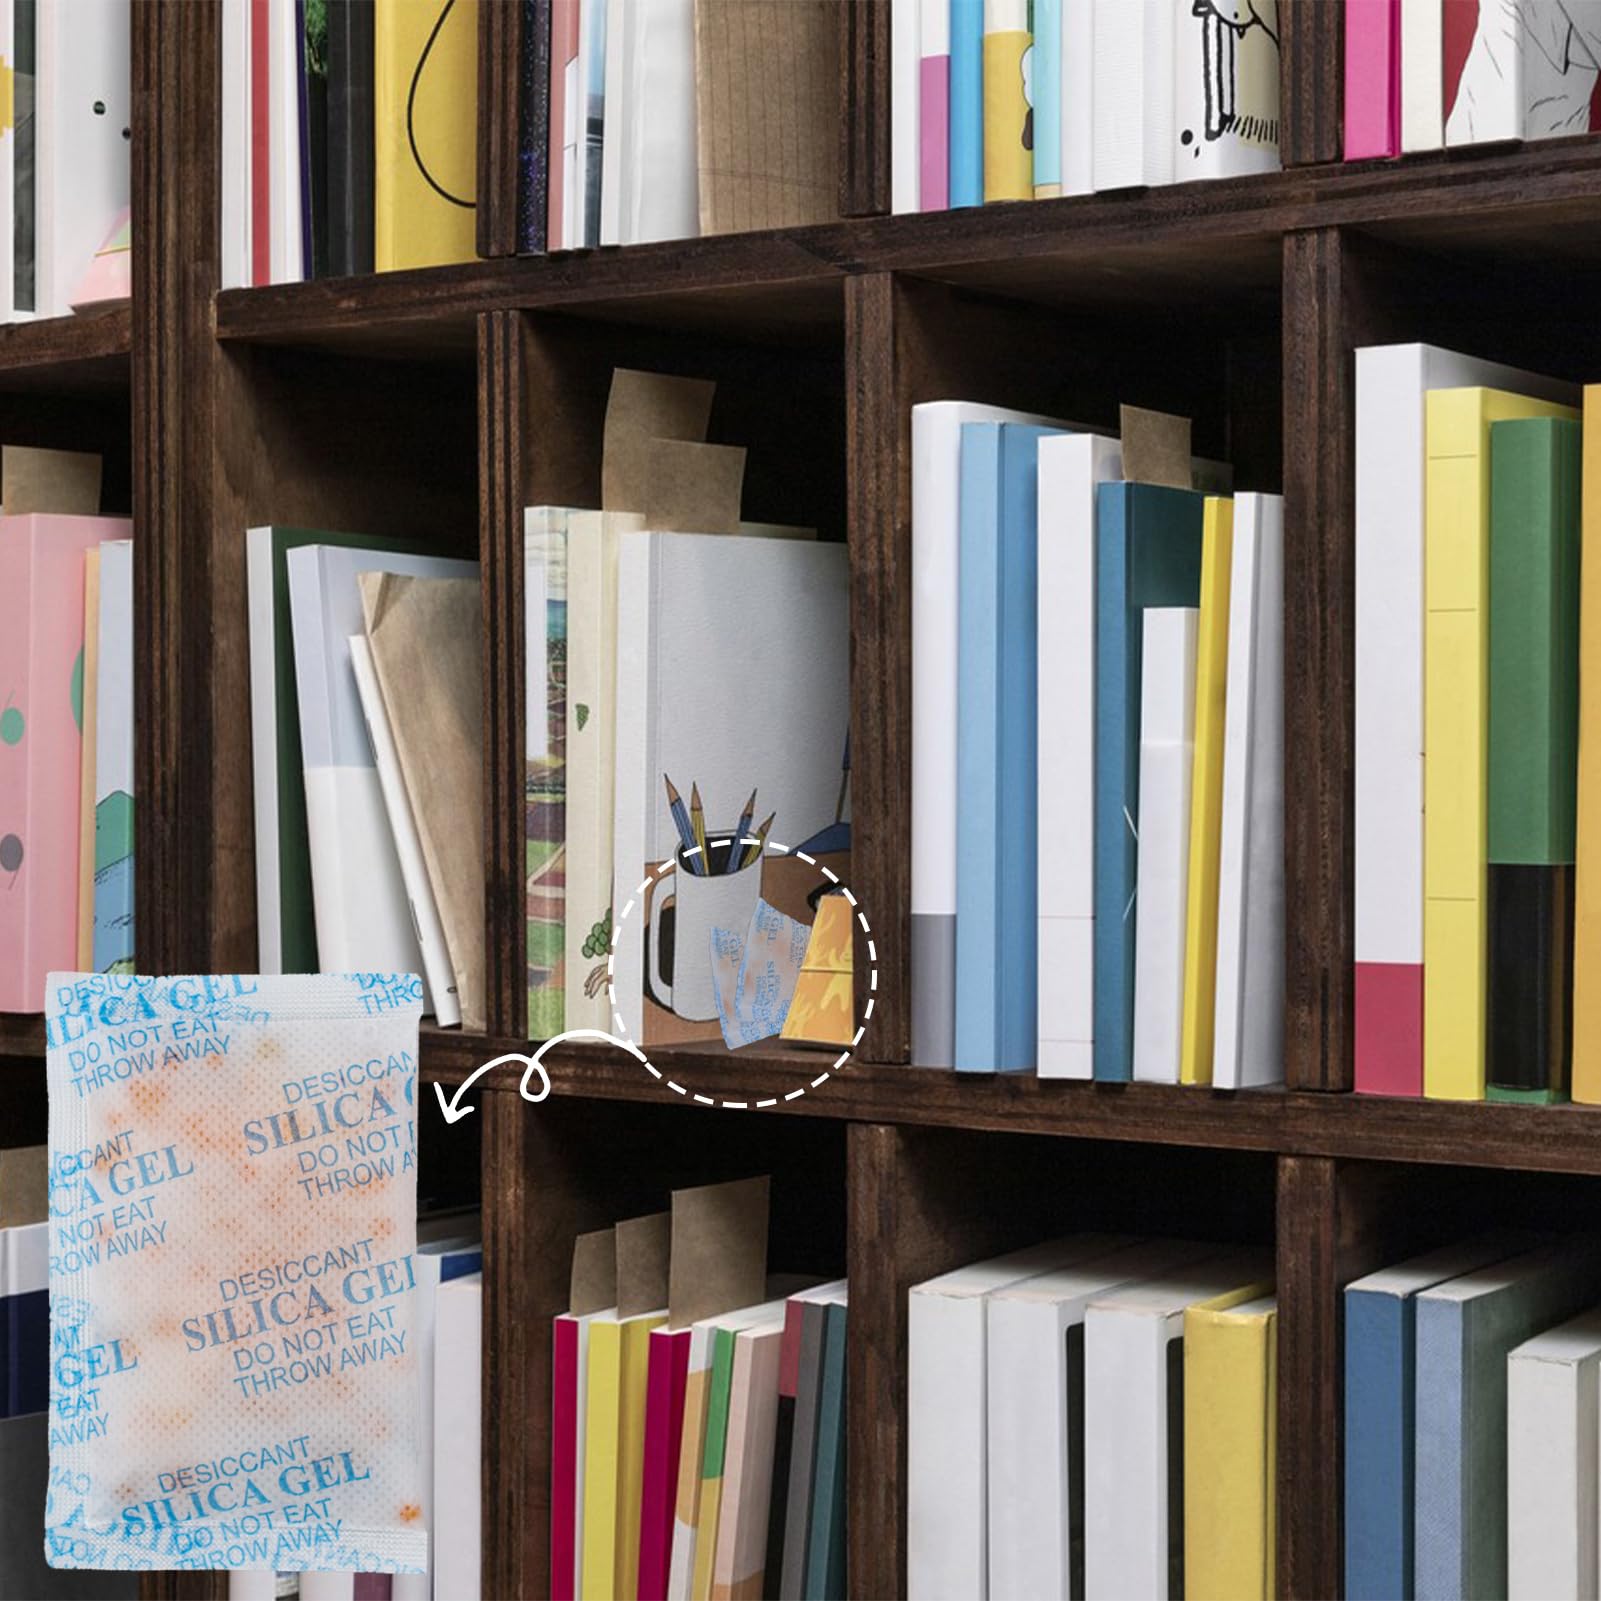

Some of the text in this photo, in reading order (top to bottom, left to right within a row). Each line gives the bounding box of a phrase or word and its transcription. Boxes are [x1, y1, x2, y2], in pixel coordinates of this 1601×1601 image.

[68, 1041, 101, 1074] DO
[107, 1024, 163, 1056] NOT
[172, 1010, 221, 1041] EAT
[71, 1034, 231, 1098] THROW AWAY
[243, 1086, 398, 1157] SILICA
[297, 1144, 339, 1174] DO
[346, 1125, 401, 1160] NOT
[108, 1143, 195, 1196] GEL
[297, 1155, 395, 1201] THROW
[57, 1195, 156, 1248] NOT EAT
[107, 1219, 167, 1261] AWAY
[219, 1238, 374, 1303] DESICCANT
[182, 1283, 336, 1352] SILICA
[233, 1305, 397, 1372] DO NOT EAT
[54, 1338, 139, 1388] GEL
[233, 1329, 407, 1399] THROW AWAY
[50, 1412, 110, 1451] AWAY
[157, 1435, 310, 1494] DESICCANT
[121, 1478, 272, 1537] SILICA
[278, 1451, 371, 1497] GEL
[219, 1510, 275, 1542] NOT
[283, 1497, 332, 1525] EAT
[275, 1519, 342, 1556] AWAY
